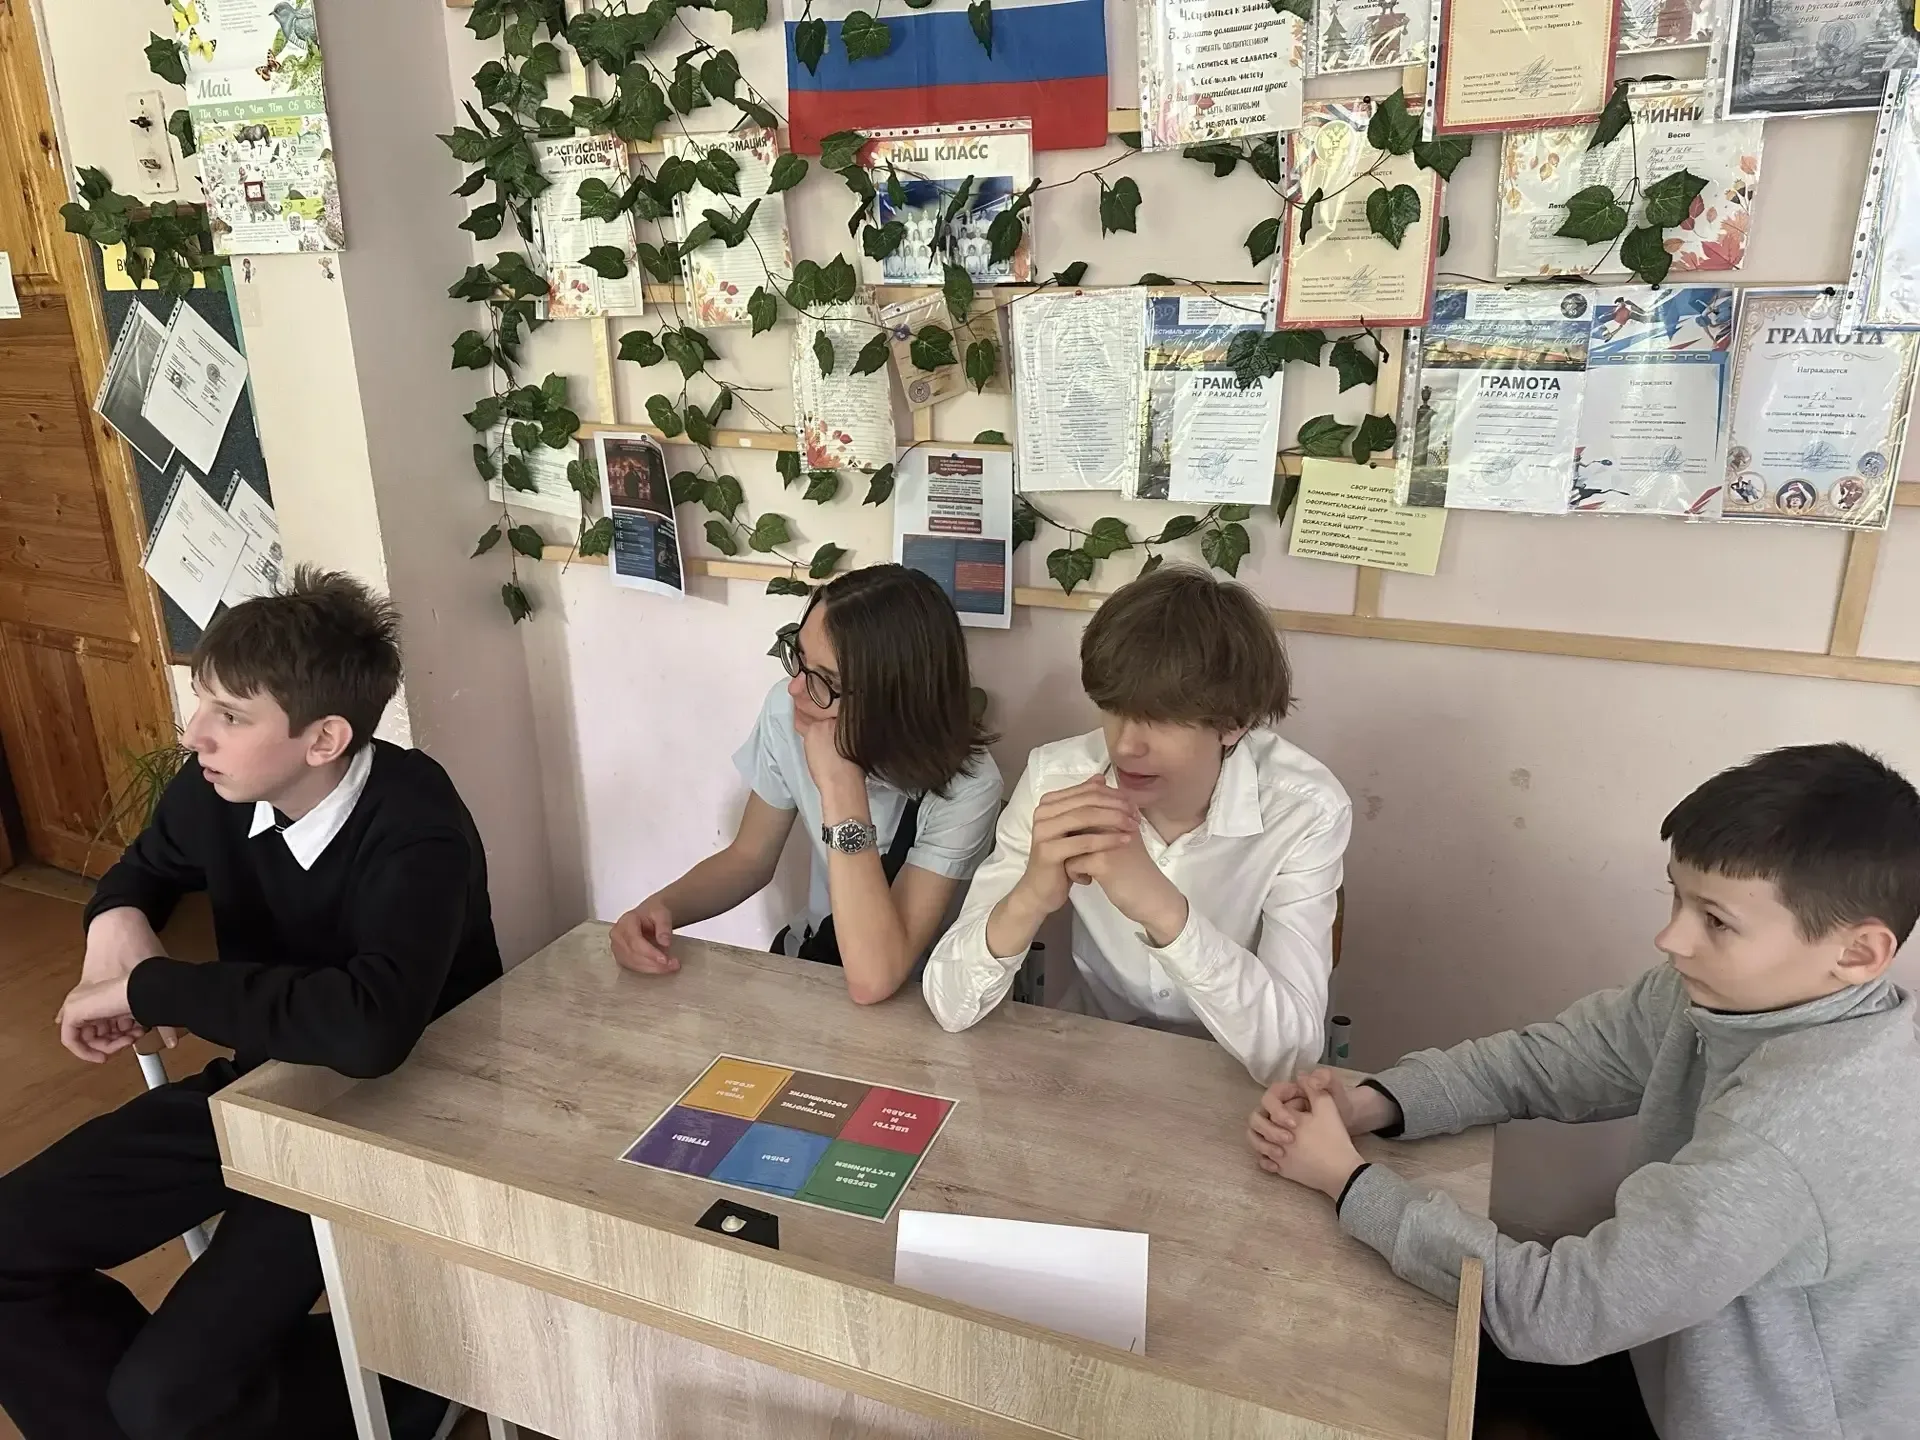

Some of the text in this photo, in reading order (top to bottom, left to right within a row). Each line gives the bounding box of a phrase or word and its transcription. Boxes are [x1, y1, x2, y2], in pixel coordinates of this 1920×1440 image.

[1806, 1, 1840, 13] русской
[1837, 12, 1871, 21] классов
[1213, 25, 1253, 37] домашние
[1254, 18, 1286, 31] задания
[1230, 56, 1239, 65] НЕ
[1240, 52, 1278, 63] СДАВАТЬСЯ
[197, 77, 232, 99] Май
[1264, 81, 1288, 94] уроке
[199, 99, 316, 119] Пн Вт Ср Чт Пт Сб Вс
[1205, 121, 1216, 129] НЕ
[1217, 118, 1238, 127] БРАТЬ
[1239, 114, 1267, 125] ЧУЖОЕ
[546, 139, 613, 156] РАСПИСАНИЕ
[891, 144, 989, 162] НАШ КЛАСС
[561, 153, 603, 166] УРОКОВ
[1765, 327, 1885, 345] ГРАМОТА
[1796, 366, 1849, 375] Награждается
[1480, 375, 1561, 391] ГРАМОТА
[1477, 390, 1559, 400] НАГРАЖДАЕТСЯ
[1305, 498, 1367, 512] ОФОРМИТЕЛЬСКИЙ
[1346, 493, 1388, 504] ЗАМЕСТИТЕЛЬ
[1303, 508, 1346, 519] ТВОРЧЕСКИЙ
[1302, 518, 1342, 529] ВОЖАТСКИЙ
[1343, 523, 1364, 531] ЦЕНТР
[1300, 528, 1321, 536] ЦЕНТР
[1321, 531, 1351, 540] ПОРЯДКА
[1319, 541, 1369, 552] ДОБРОВОЛЬЦЕВ
[1297, 547, 1339, 558] СПОРТИВНЫЙ
[1340, 553, 1361, 561] ЦЕНТР
[724, 1079, 756, 1089] ЯГОДЫ
[716, 1090, 745, 1100] ГРИБЫ
[788, 1089, 848, 1109] ВОСЬМИНОГИЕ
[780, 1101, 836, 1120] ШЕСТИНОГИЕ
[881, 1107, 918, 1120] ТРАВЫ
[873, 1120, 910, 1134] ЦВЕТЫ
[671, 1133, 711, 1147] ПТИЦЫ
[761, 1153, 791, 1164] РЫБЫ
[834, 1160, 897, 1178] КУСТАРНИКИ
[836, 1175, 878, 1189] ДЕРЕВЬЯ
